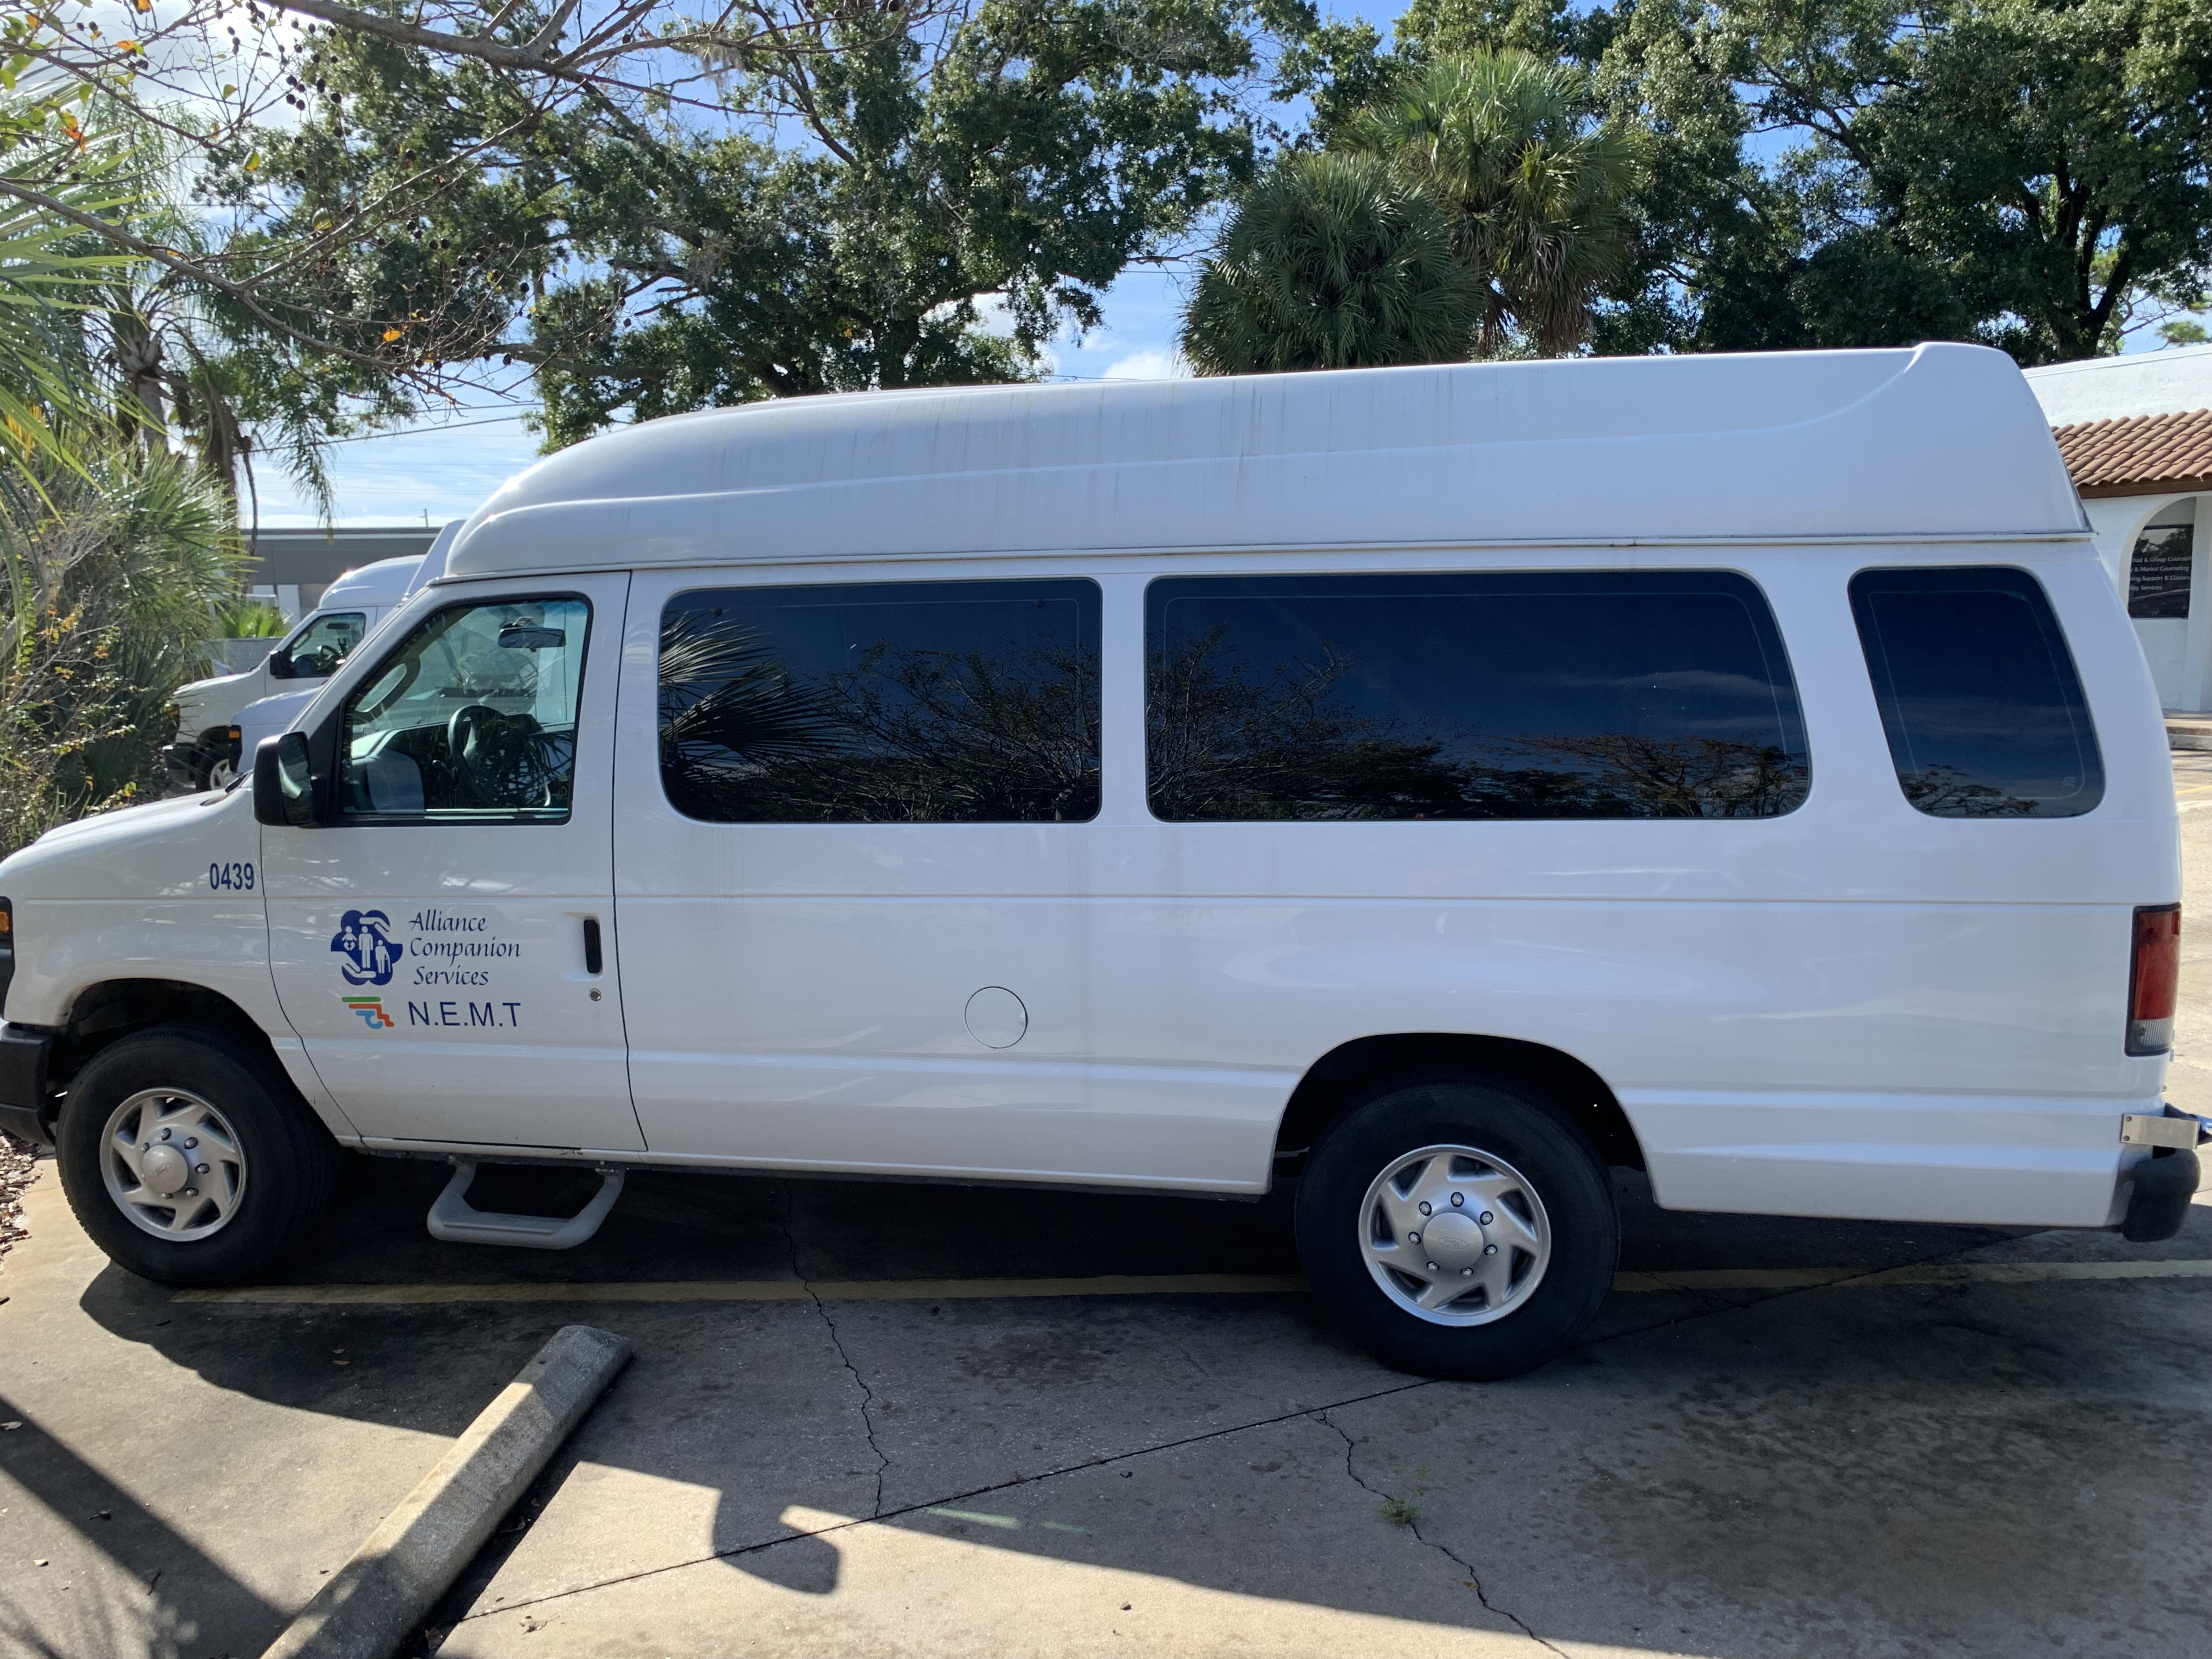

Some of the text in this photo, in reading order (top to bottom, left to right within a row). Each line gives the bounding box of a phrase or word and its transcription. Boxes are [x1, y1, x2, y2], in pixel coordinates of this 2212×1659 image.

[209, 863, 255, 890] 0439
[408, 909, 488, 932] Alliance
[410, 936, 522, 966] Companion
[414, 966, 488, 986] Services
[408, 1001, 521, 1027] N.E.M.T
